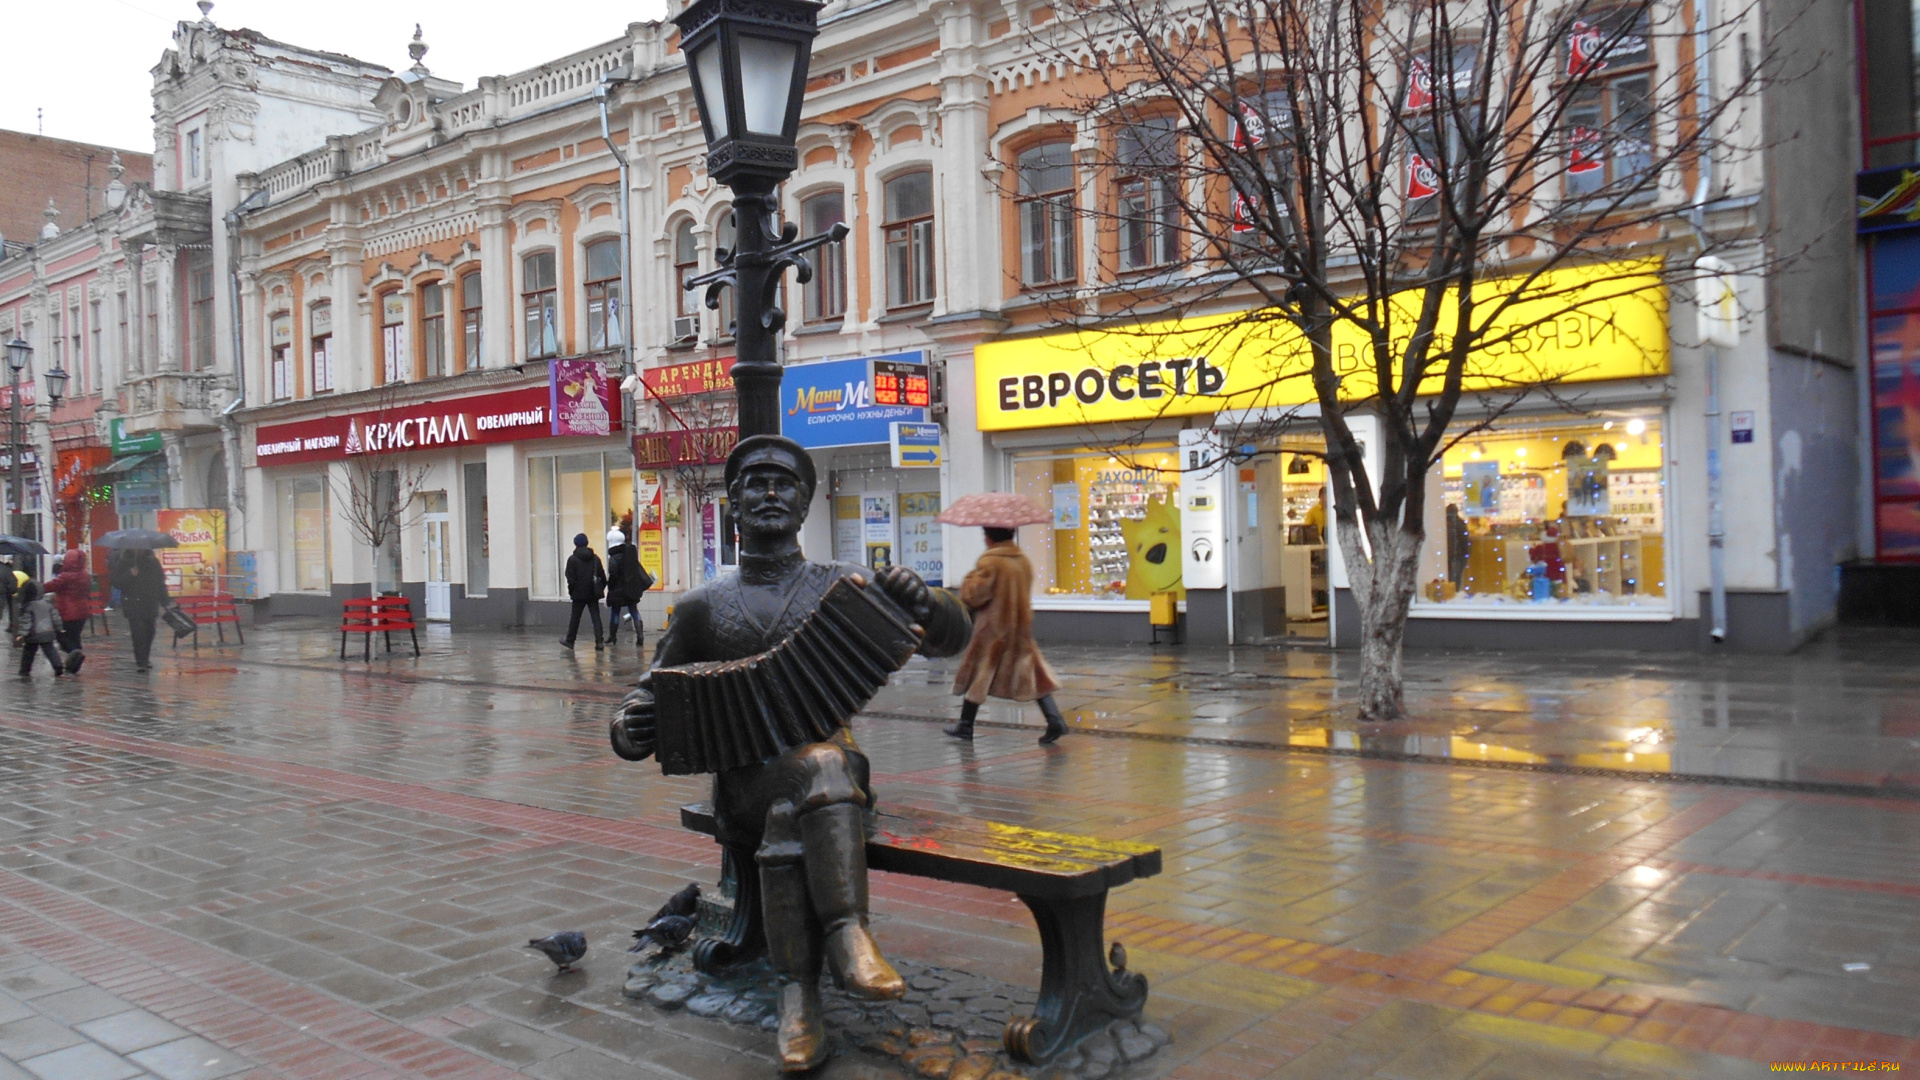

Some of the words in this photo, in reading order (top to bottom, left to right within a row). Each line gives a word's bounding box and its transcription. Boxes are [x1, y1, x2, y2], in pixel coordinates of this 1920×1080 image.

[1481, 313, 1616, 356] СВЯЗИ
[660, 361, 724, 383] АРЕНДА
[999, 357, 1223, 411] ЕВРОСЕТЬ
[568, 400, 596, 408] САЛОН
[807, 415, 827, 425] ЕСЛИ
[827, 412, 855, 424] СРОЧНО
[857, 409, 884, 419] НУЖНЫ
[883, 407, 913, 418] ДЕНЬГИ
[365, 413, 469, 451] КРИСТАЛЛ
[477, 406, 543, 431] ЮВЕЛИРНЫЙ
[257, 437, 301, 456] ЮВЕЛИРНЫЙ
[303, 435, 339, 450] МАГАЗИН
[637, 436, 671, 464] БАНК
[679, 430, 739, 461] АГРОР
[1096, 467, 1161, 485] ЗАХОДИ!
[171, 529, 213, 542] УЛЫБКА
[913, 522, 928, 535] 15
[914, 540, 928, 553] 15
